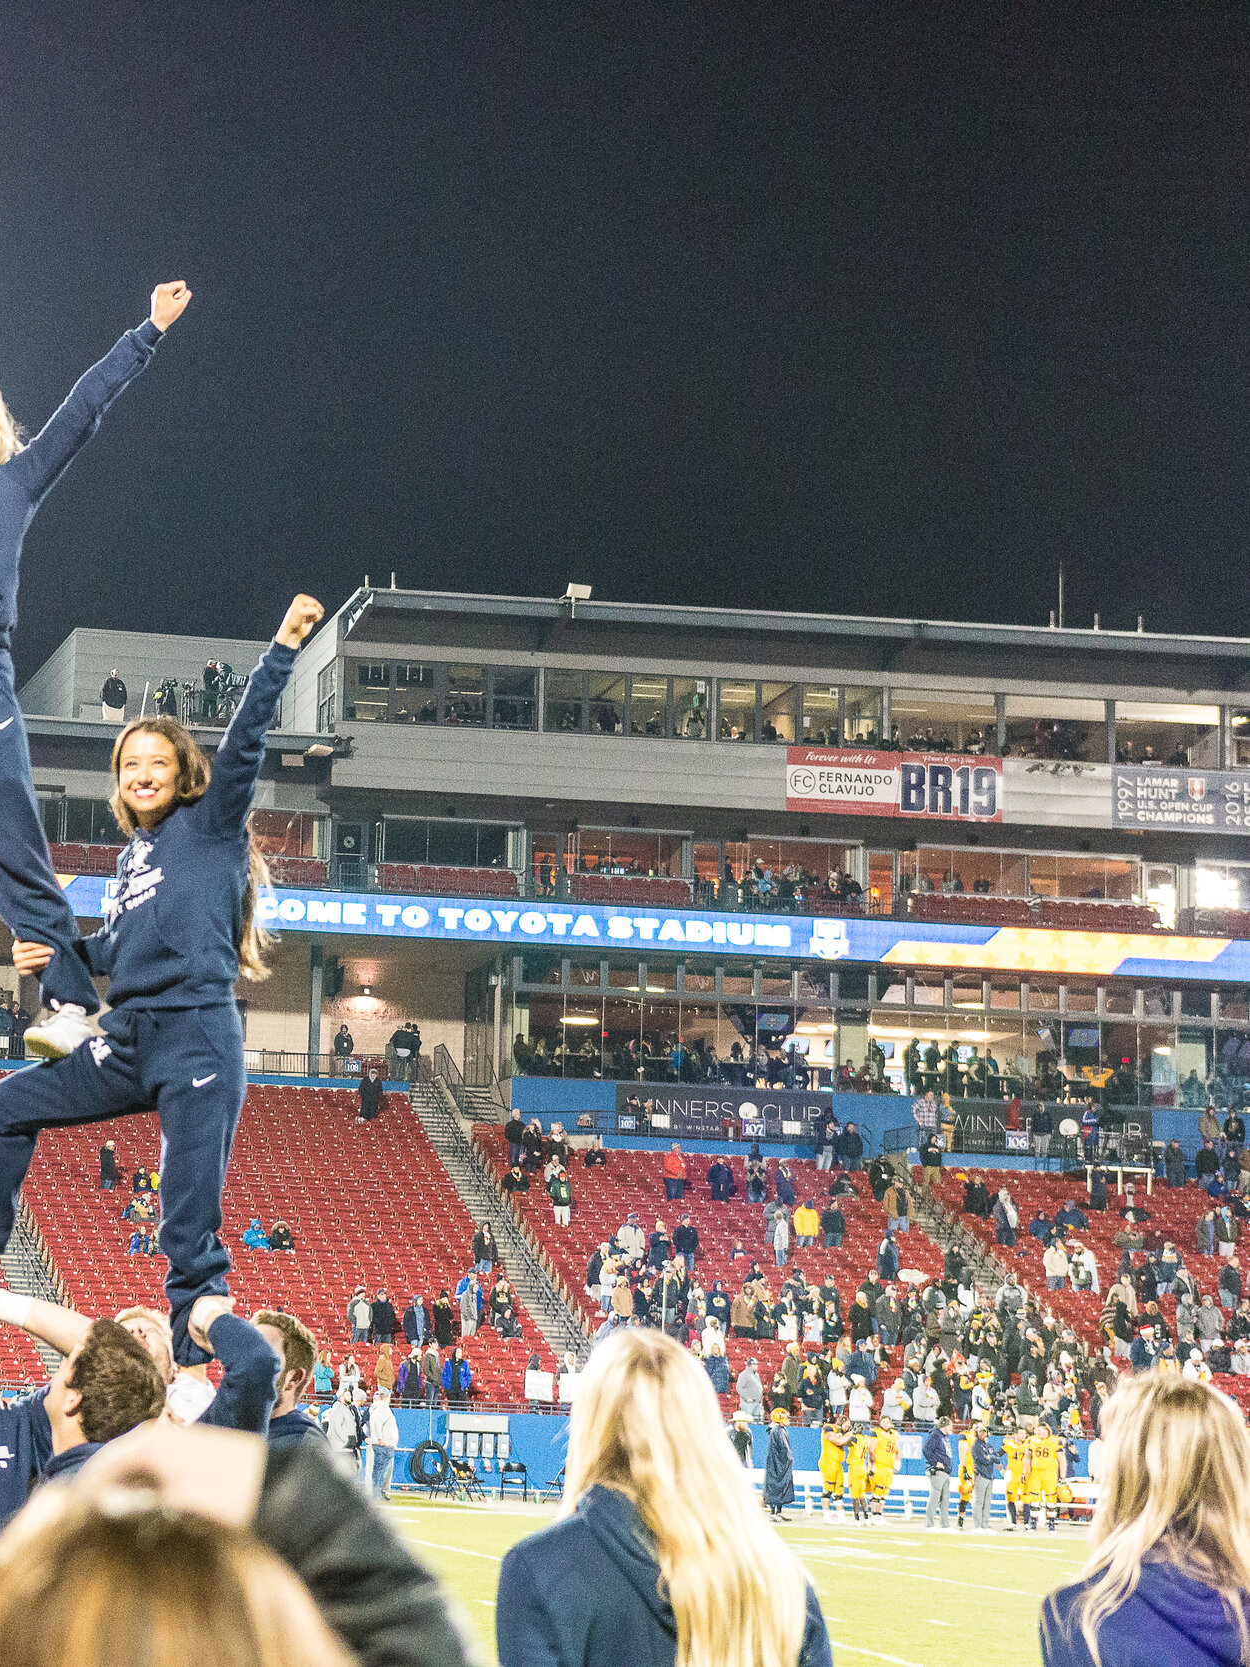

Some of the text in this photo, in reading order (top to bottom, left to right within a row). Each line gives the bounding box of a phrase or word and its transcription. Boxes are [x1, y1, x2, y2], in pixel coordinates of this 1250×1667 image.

[805, 751, 838, 763] Forever
[840, 753, 862, 764] with
[819, 772, 893, 786] FERNANDO
[1136, 777, 1179, 788] LAMAR
[819, 783, 875, 796] CLAVIJO
[901, 764, 998, 817] BR19
[1136, 787, 1178, 800] HUNT
[1117, 776, 1134, 820] 1997
[1225, 782, 1241, 825] 2016
[1137, 800, 1214, 813] U.S. OPEN CUP
[1136, 810, 1214, 825] CHAMPIONS
[376, 904, 429, 928] TO
[438, 907, 599, 937] TOYOTA
[607, 915, 791, 947] STADIUM
[346, 1063, 359, 1071] 108
[620, 1120, 634, 1129] 107
[744, 1123, 764, 1136] 107
[1006, 1136, 1027, 1147] 106
